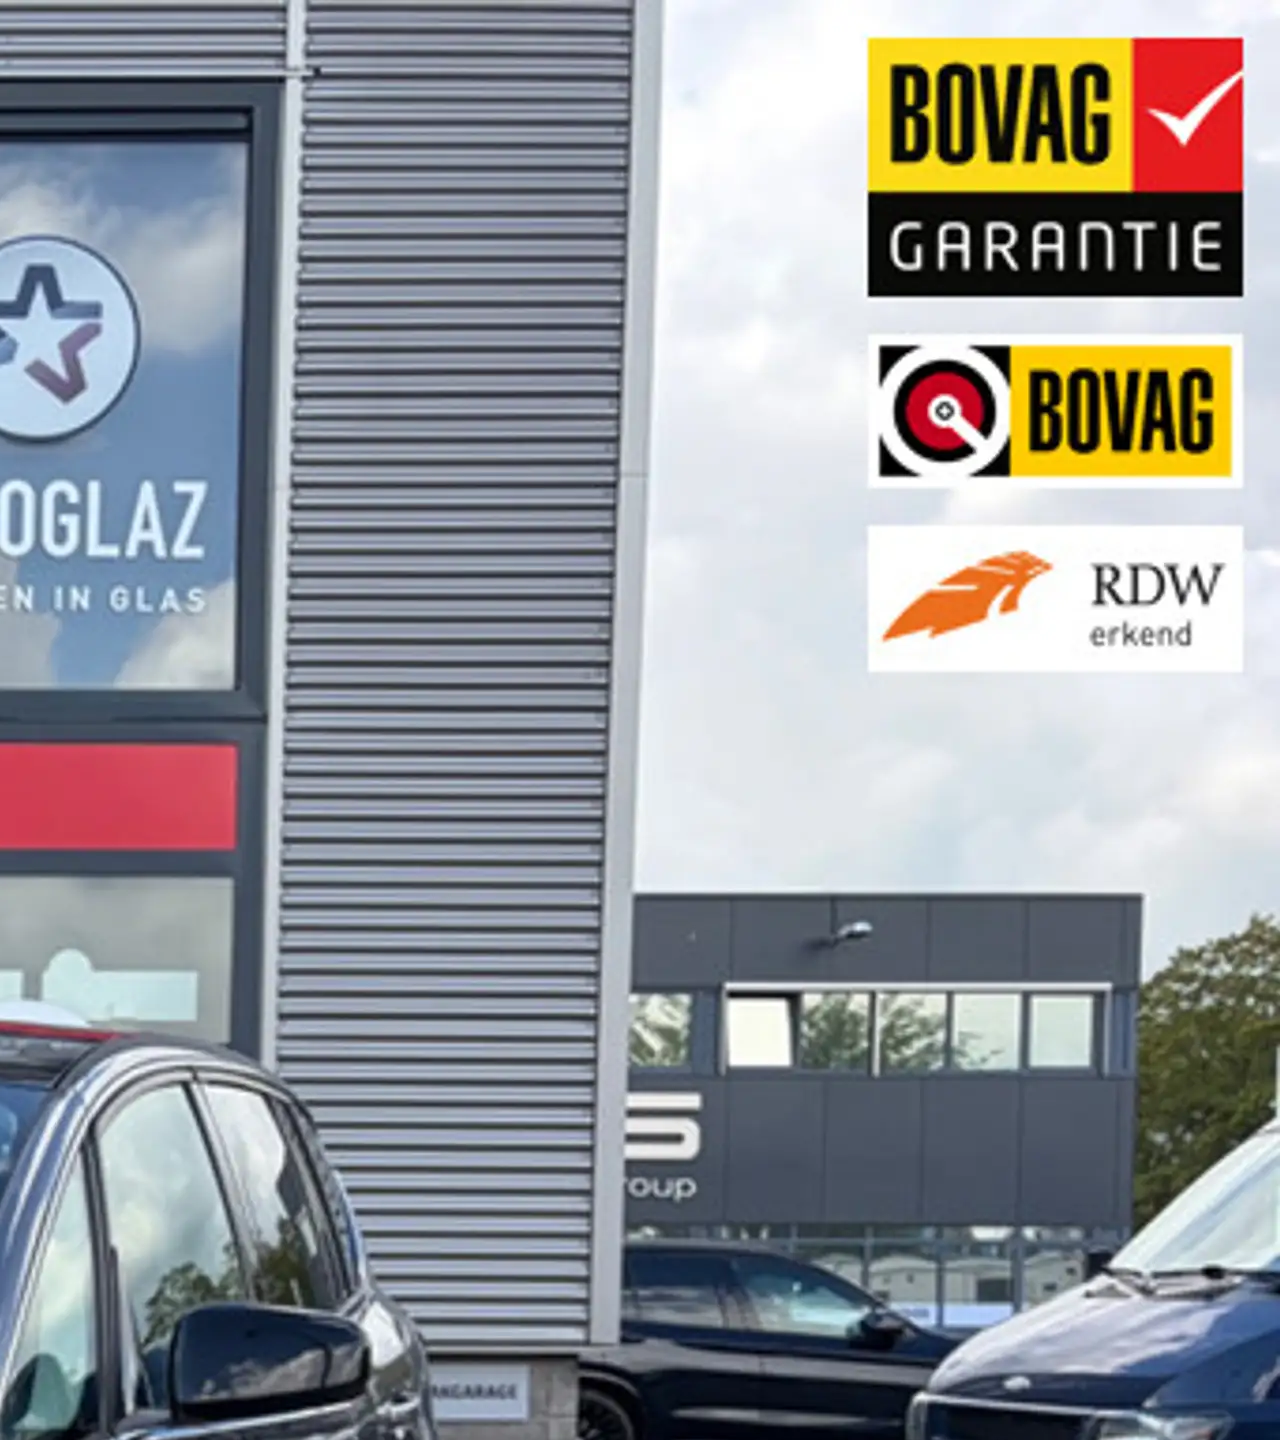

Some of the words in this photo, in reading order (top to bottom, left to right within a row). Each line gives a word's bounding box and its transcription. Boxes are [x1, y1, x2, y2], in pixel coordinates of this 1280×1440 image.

[54, 586, 92, 611] IN
[109, 586, 208, 613] GLAS
[624, 1177, 698, 1202] oup
